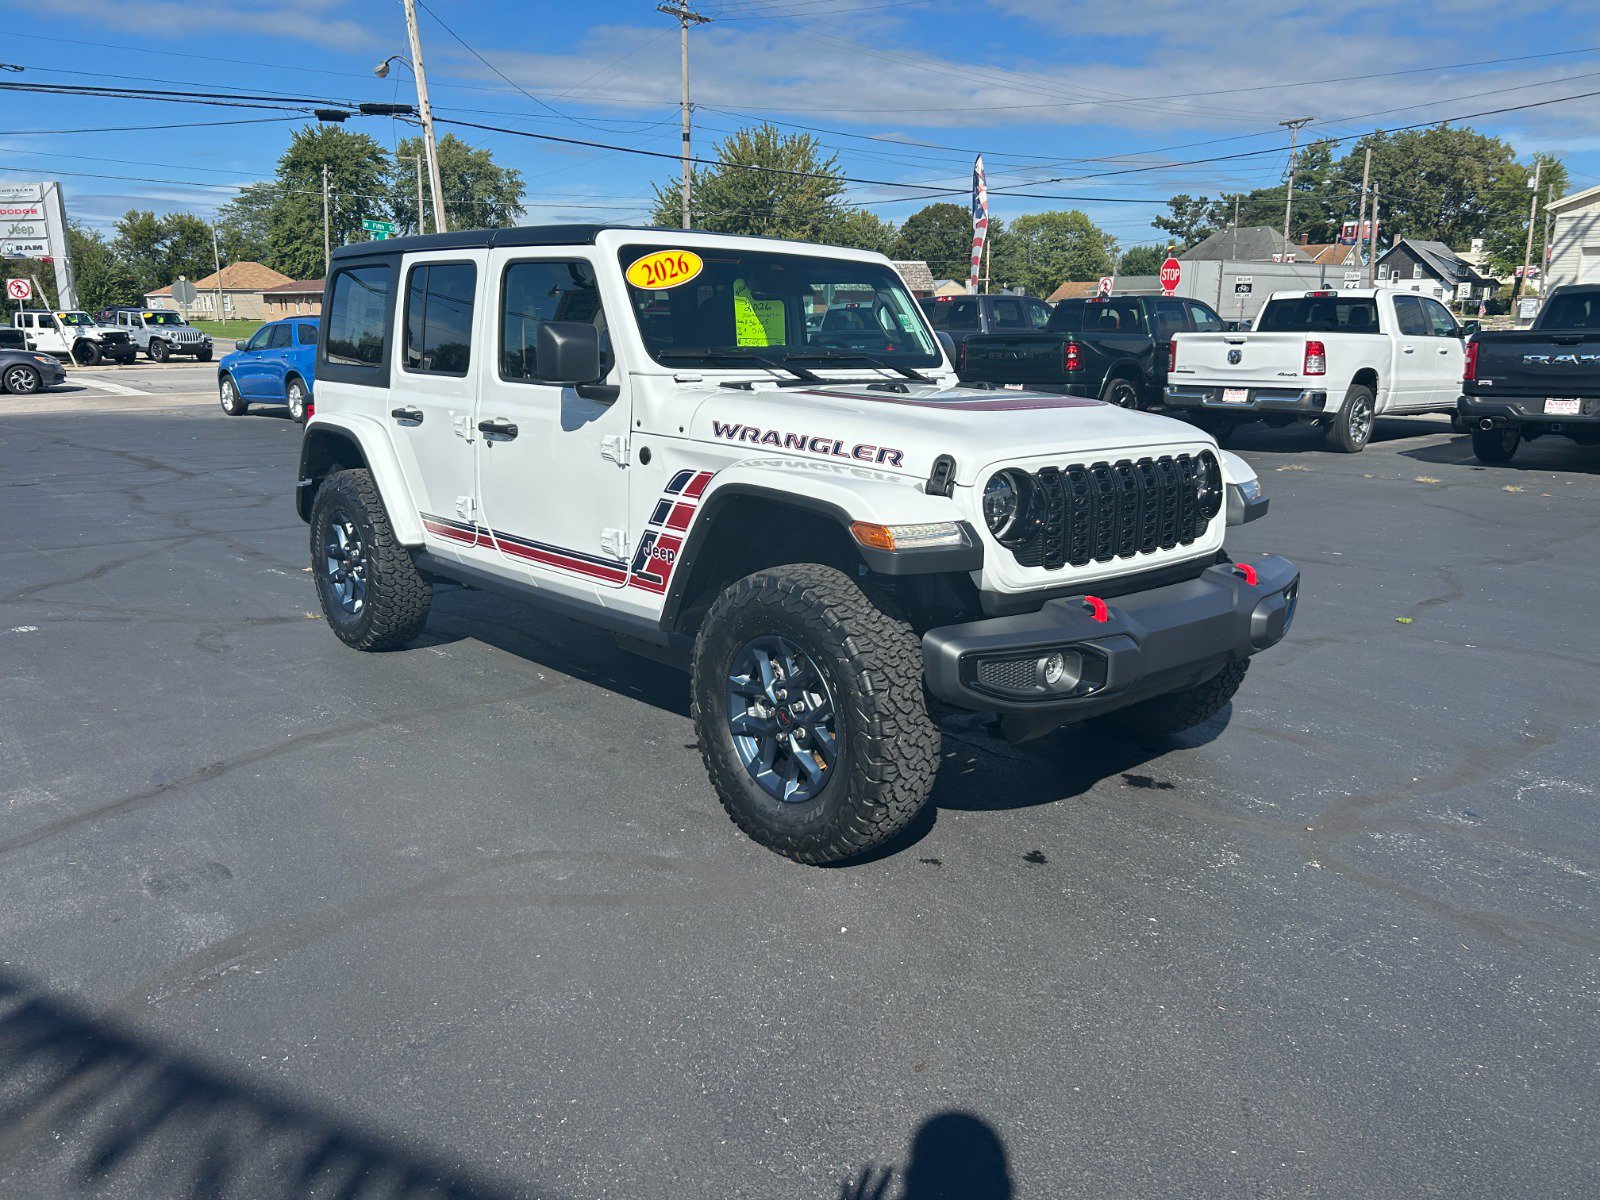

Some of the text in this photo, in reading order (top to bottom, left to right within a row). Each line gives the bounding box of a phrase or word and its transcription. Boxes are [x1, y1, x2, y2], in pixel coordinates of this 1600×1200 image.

[8, 224, 35, 236] Jeep
[641, 254, 689, 285] 2026
[1161, 268, 1180, 281] STOP
[744, 301, 771, 312] 2026
[712, 420, 904, 467] WRANGLER
[643, 541, 676, 565] Jeep
